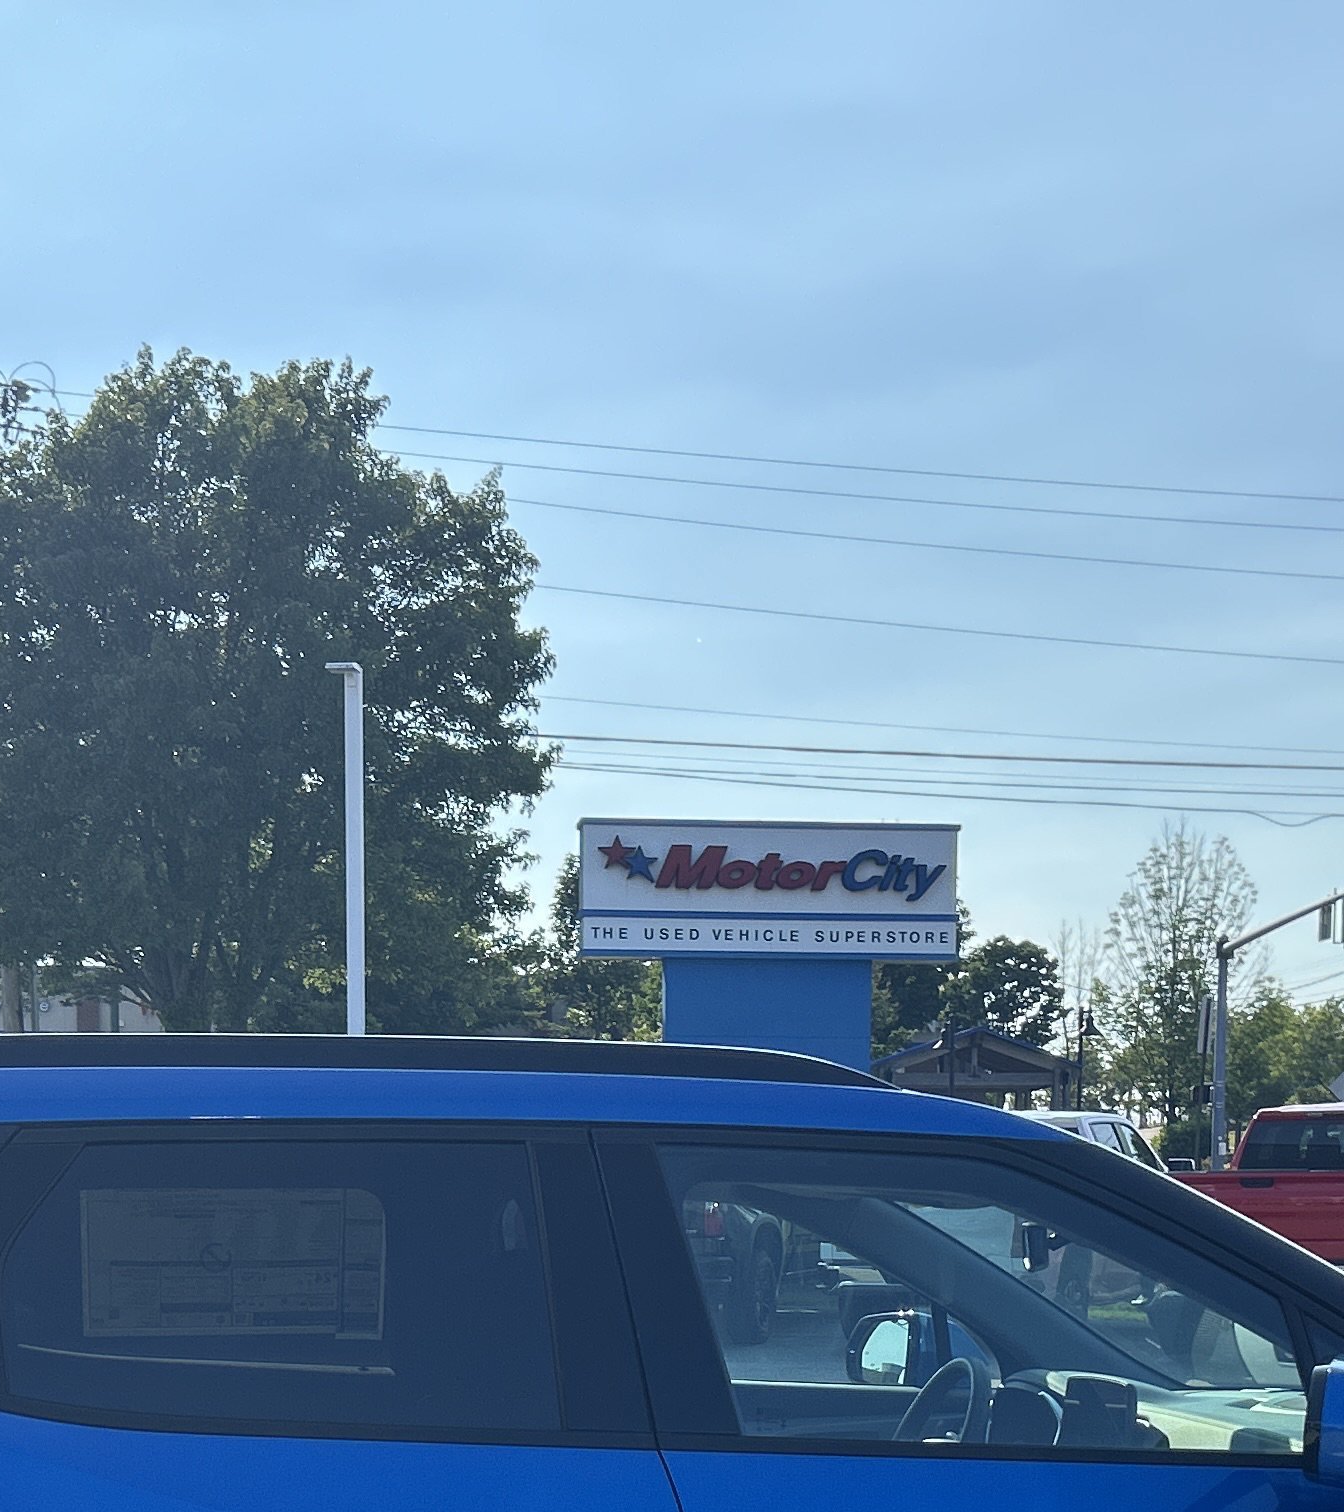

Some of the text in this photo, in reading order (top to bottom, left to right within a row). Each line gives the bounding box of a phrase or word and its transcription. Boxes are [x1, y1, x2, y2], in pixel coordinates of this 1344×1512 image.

[655, 844, 947, 902] MotorCity
[591, 926, 949, 944] THE USED VEHICLE SUPERSTORE
